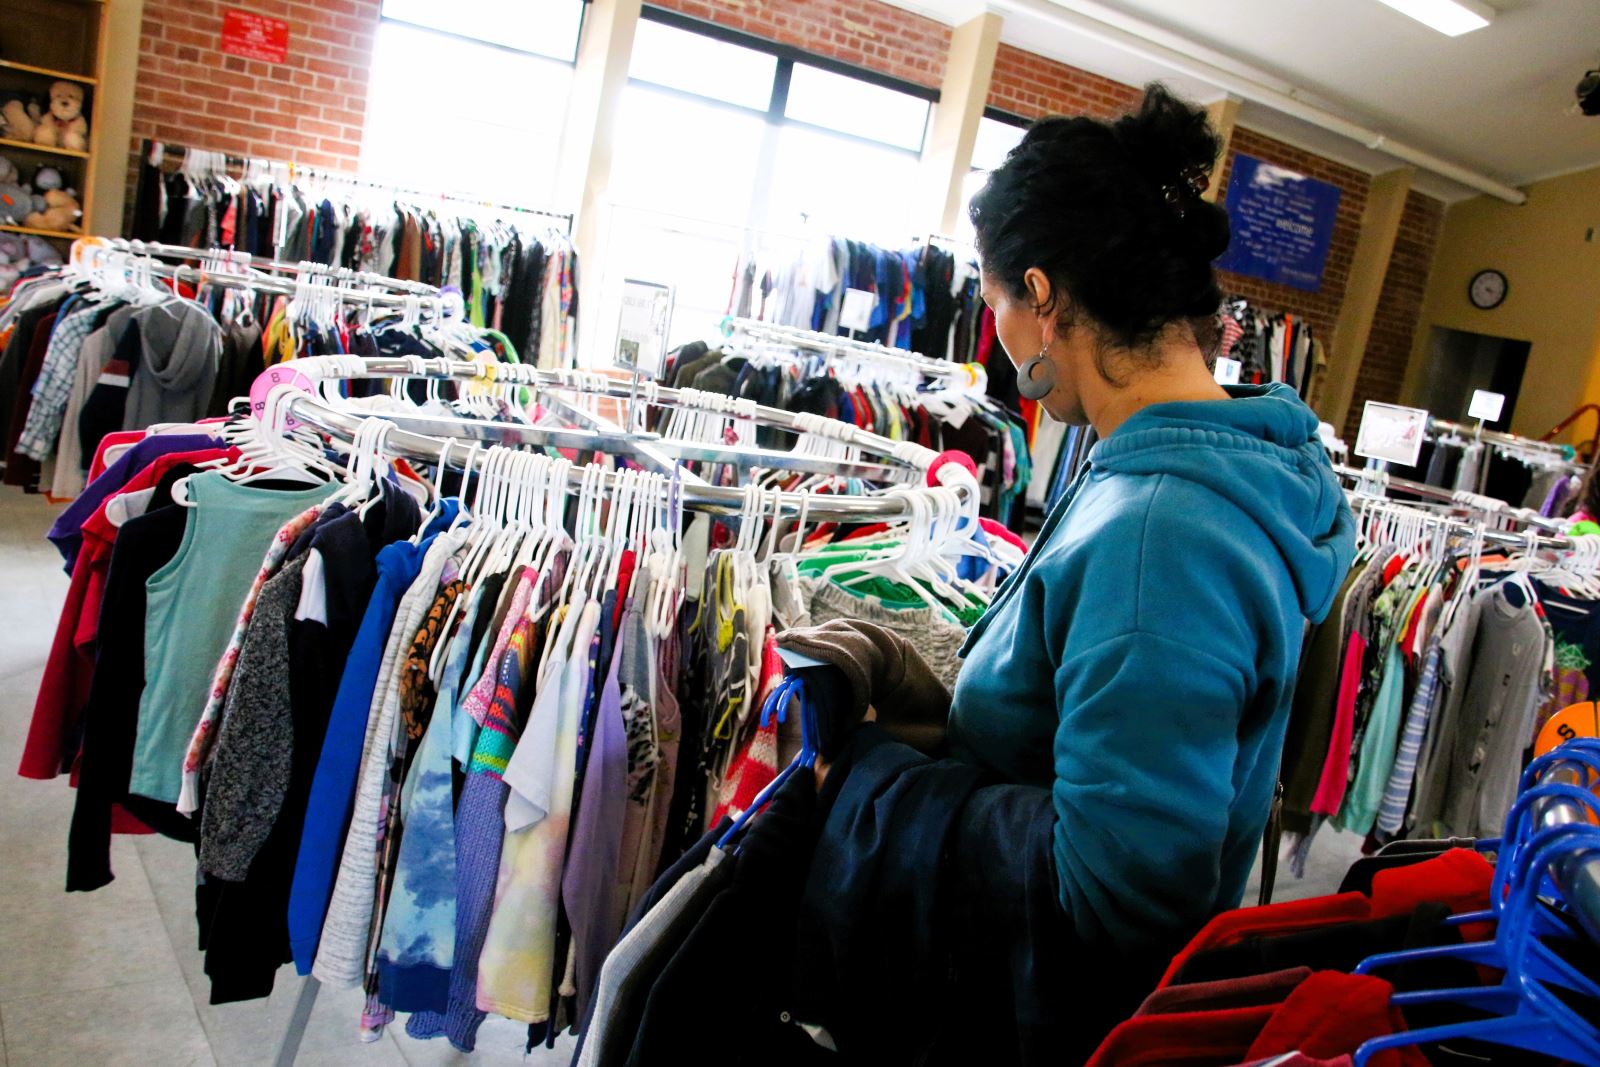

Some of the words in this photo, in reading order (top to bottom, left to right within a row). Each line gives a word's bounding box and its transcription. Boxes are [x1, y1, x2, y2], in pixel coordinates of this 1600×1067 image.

[1276, 218, 1313, 237] welcome
[271, 372, 281, 383] 8
[255, 401, 265, 410] 8
[1557, 723, 1576, 740] S
